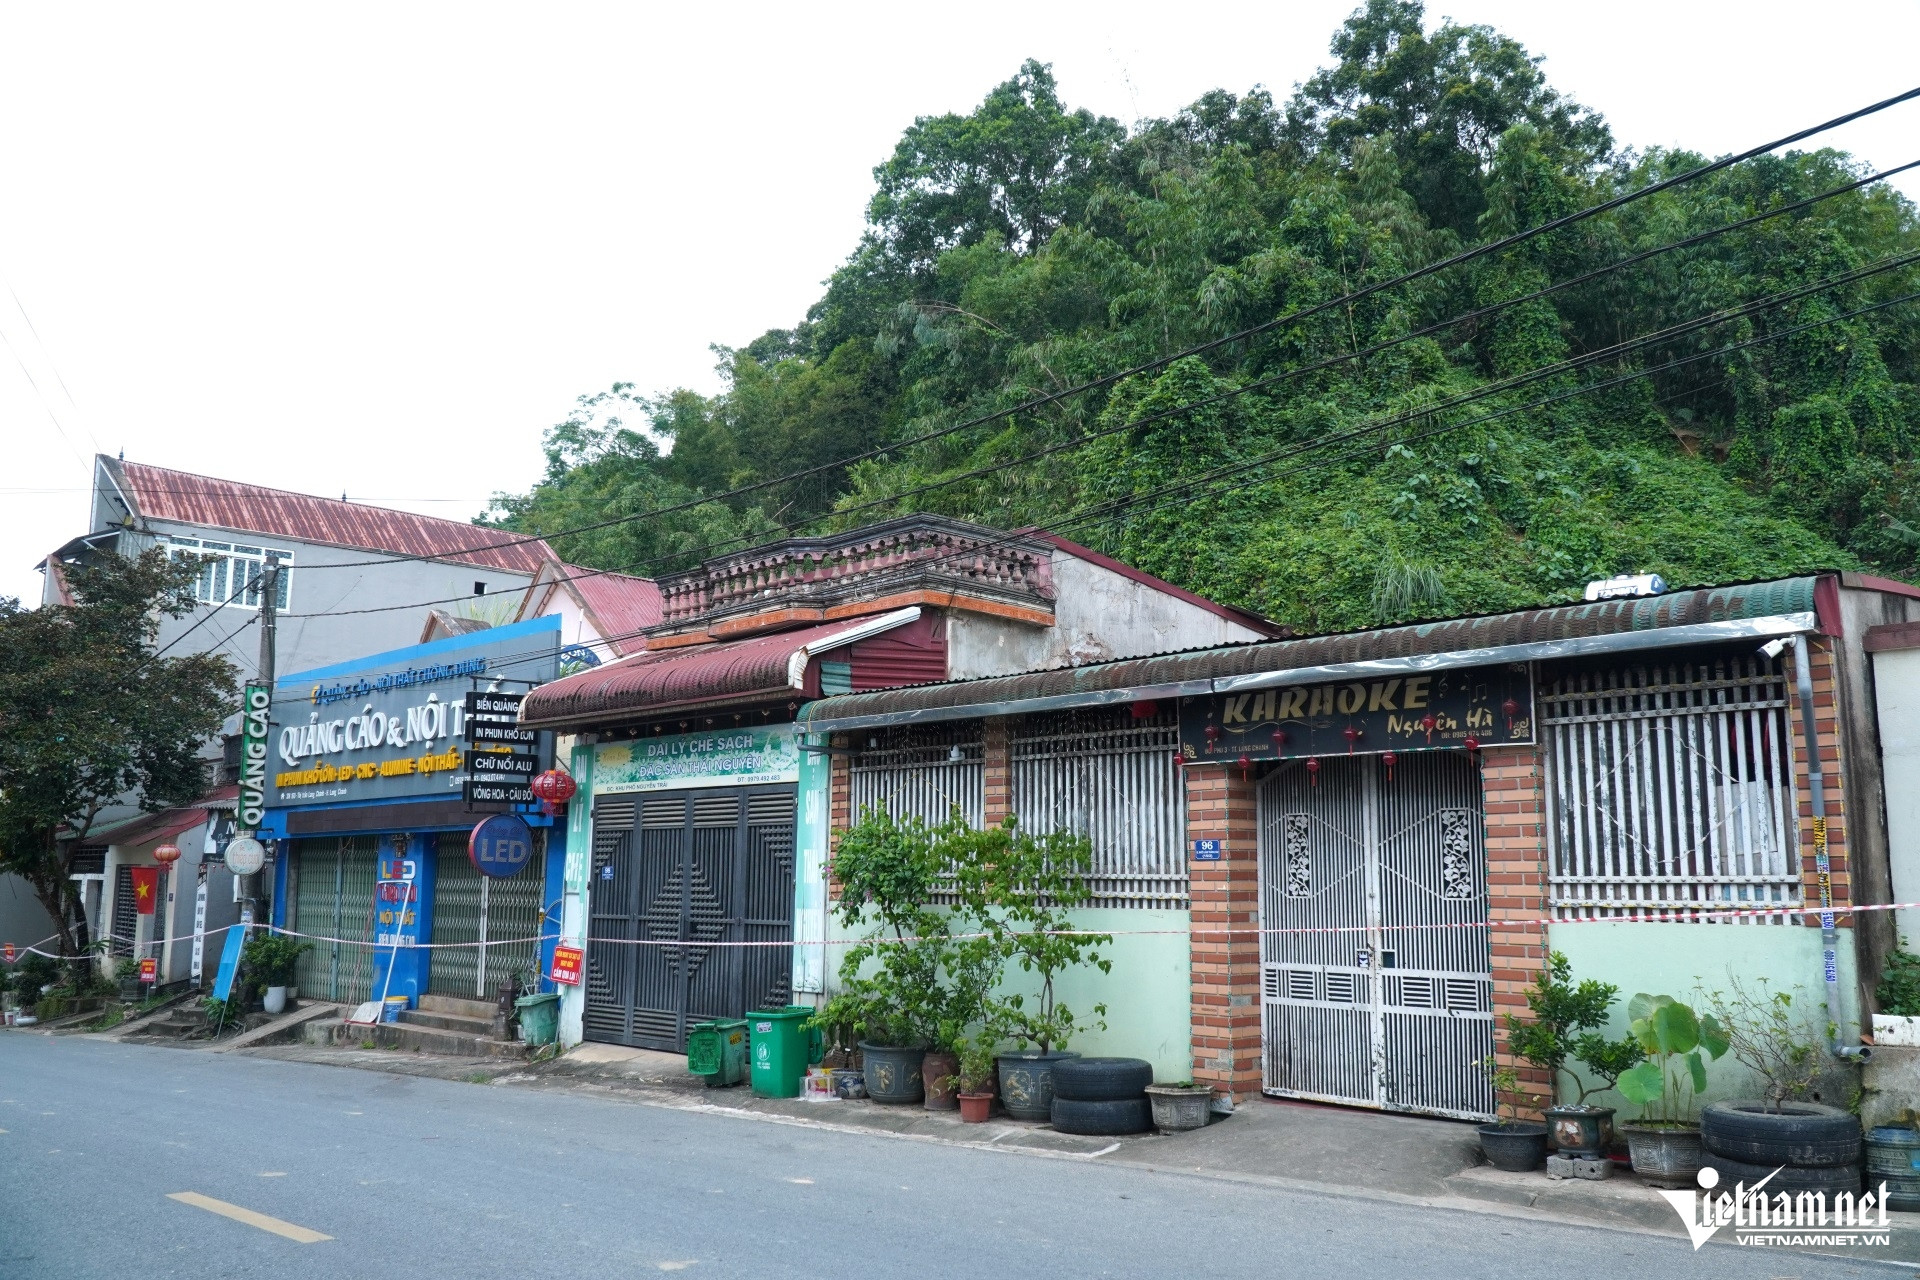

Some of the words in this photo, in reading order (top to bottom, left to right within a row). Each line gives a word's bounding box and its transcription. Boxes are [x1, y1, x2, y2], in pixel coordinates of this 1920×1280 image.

[476, 695, 491, 710] BIỂN
[492, 697, 519, 713] QUẢNG
[1223, 676, 1432, 724] KARAOKE
[241, 690, 271, 739] CÁO
[1466, 707, 1493, 728] Hà
[278, 711, 344, 767] QUẢNG
[345, 703, 388, 750] CÁO
[387, 717, 407, 748] &
[406, 692, 448, 749] NỘI
[475, 727, 484, 738] IN
[485, 728, 503, 739] PHUN
[504, 724, 519, 740] KHỔ
[647, 742, 668, 760] ĐẠI
[671, 737, 685, 754] LÝ
[690, 736, 713, 753] CHÈ
[717, 735, 753, 753] SẠCH
[338, 765, 354, 781] LED
[475, 756, 496, 769] CHỮ
[497, 754, 514, 771] NỔI
[516, 761, 533, 771] ALU
[639, 761, 662, 779] ĐẶC
[664, 760, 686, 774] SẢN
[688, 758, 711, 773] THÁI
[714, 753, 761, 773] NGUYÊN
[237, 742, 266, 826] QUẢNG
[473, 784, 491, 799] VÒNG
[492, 787, 504, 799] HOA
[509, 786, 521, 800] CÂU
[522, 786, 533, 801] ĐỐI
[480, 838, 527, 863] LED
[1201, 841, 1213, 850] 96
[382, 860, 416, 880] LED
